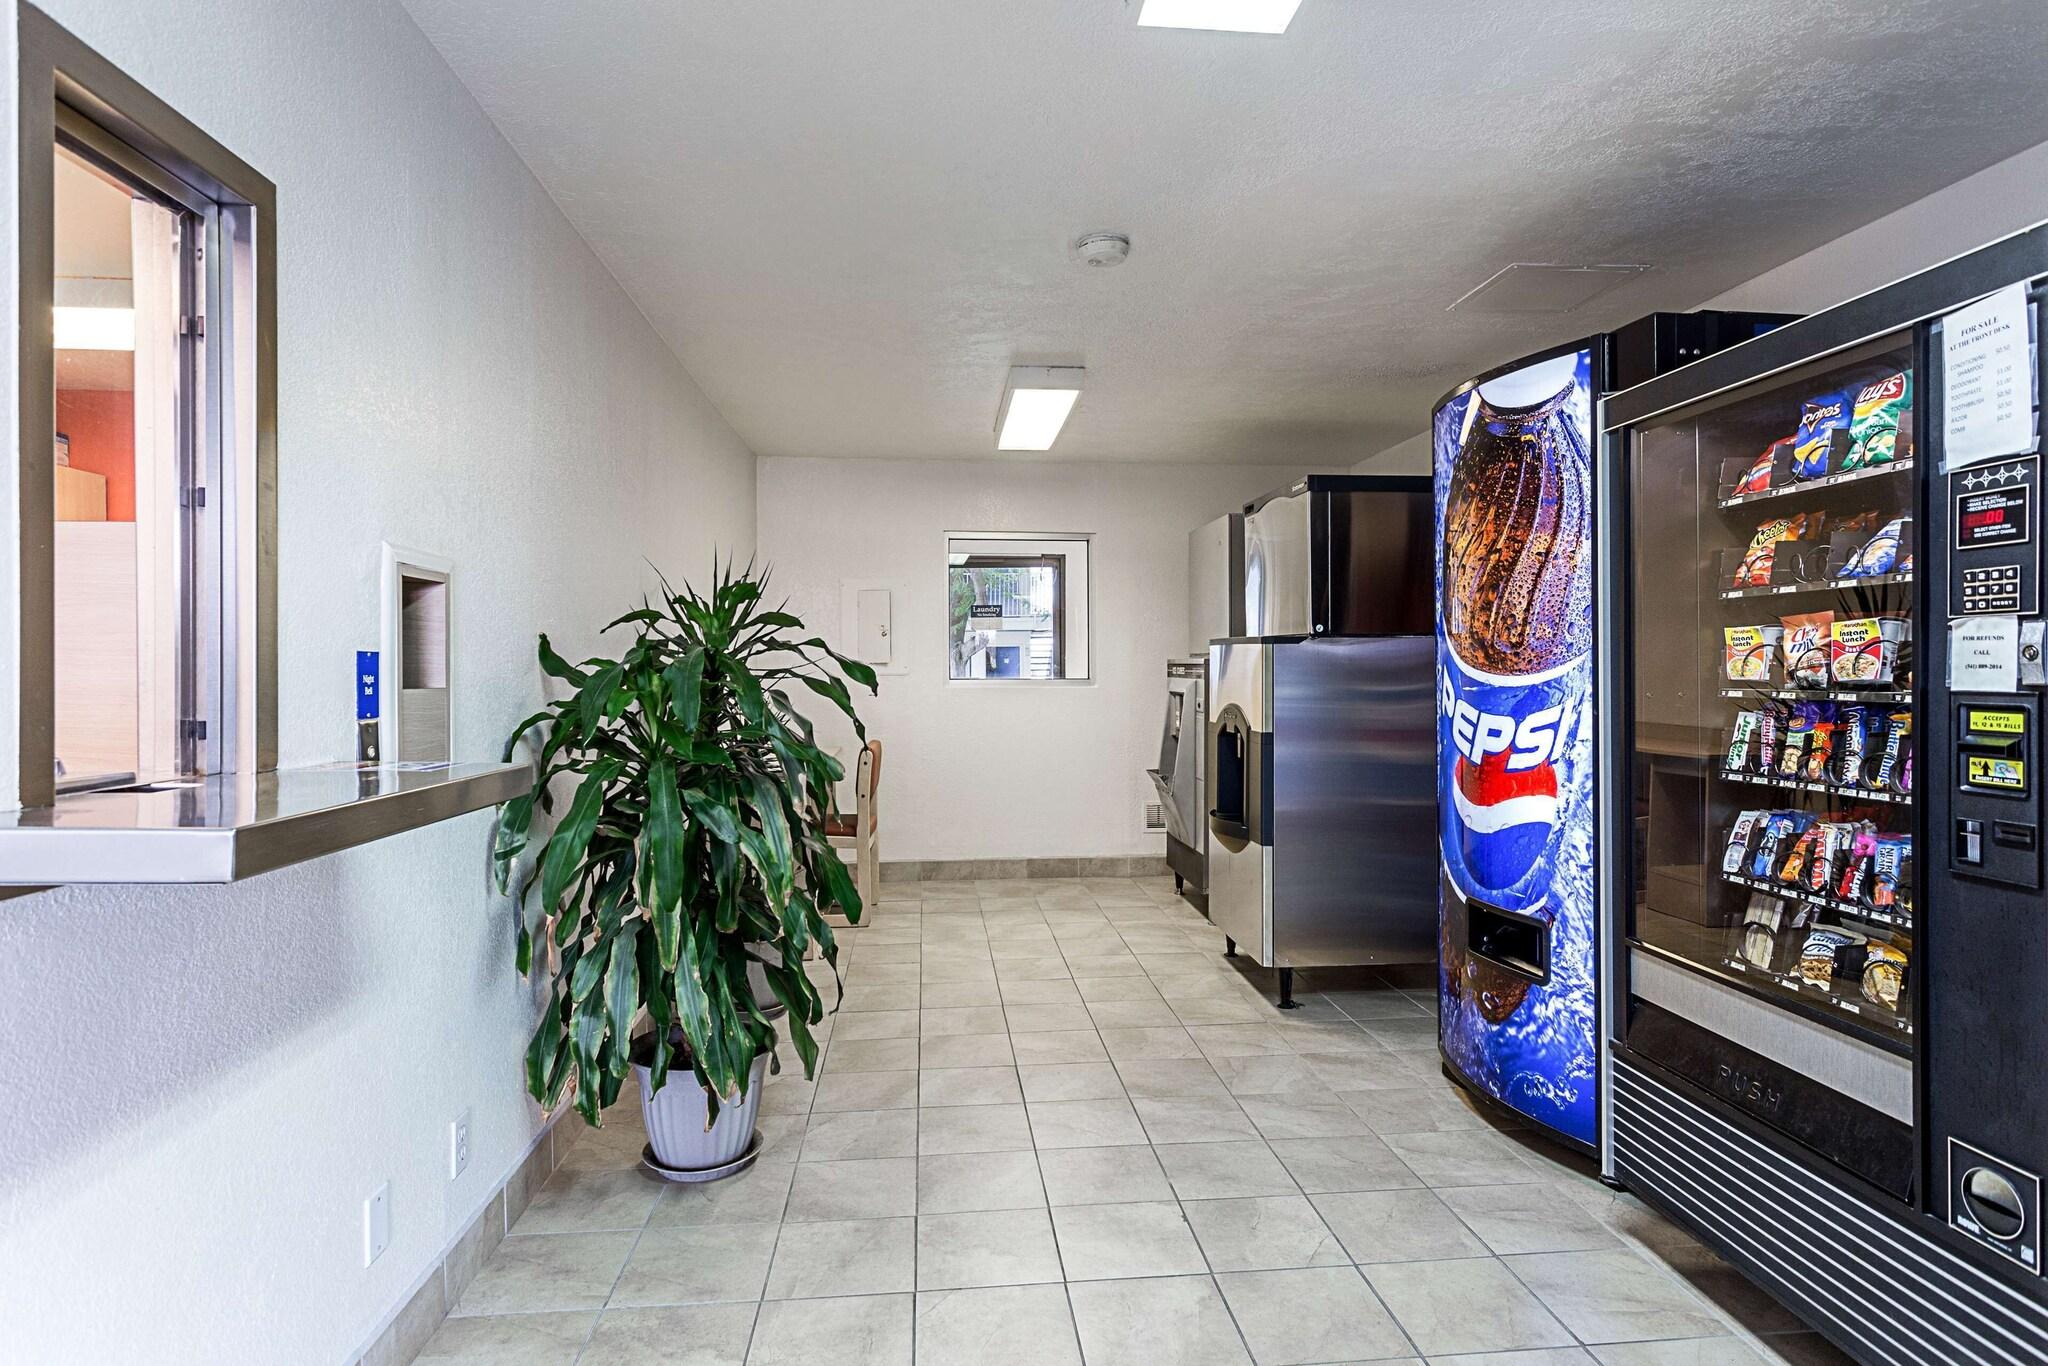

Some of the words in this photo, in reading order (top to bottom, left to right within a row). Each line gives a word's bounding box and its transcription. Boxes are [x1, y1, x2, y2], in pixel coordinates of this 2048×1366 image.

[1961, 325, 1976, 336] FOR
[1978, 316, 1999, 329] SALE
[1949, 344, 1957, 352] AT
[1958, 338, 1971, 349] THE
[1972, 331, 1993, 344] FRONT
[1994, 324, 2010, 335] DESK
[1957, 364, 1984, 377] SHAMPOO
[1951, 376, 1982, 391] DEODORANT
[1951, 399, 1984, 412] TOOTHBRUSH
[1951, 414, 1968, 424] RAZOR
[1951, 426, 1966, 435] COMB
[1991, 571, 1999, 579] 3
[2006, 570, 2013, 578] 4
[1992, 585, 1999, 593] 7
[363, 674, 375, 685] Night
[1442, 664, 1574, 770] PEPSI
[1736, 715, 1750, 760] Junior
[1878, 720, 1906, 784] Buttefinge
[1812, 830, 1826, 890] PAYDAY
[1886, 848, 1894, 874] NUTRI
[1716, 1064, 1780, 1112] PUSH
